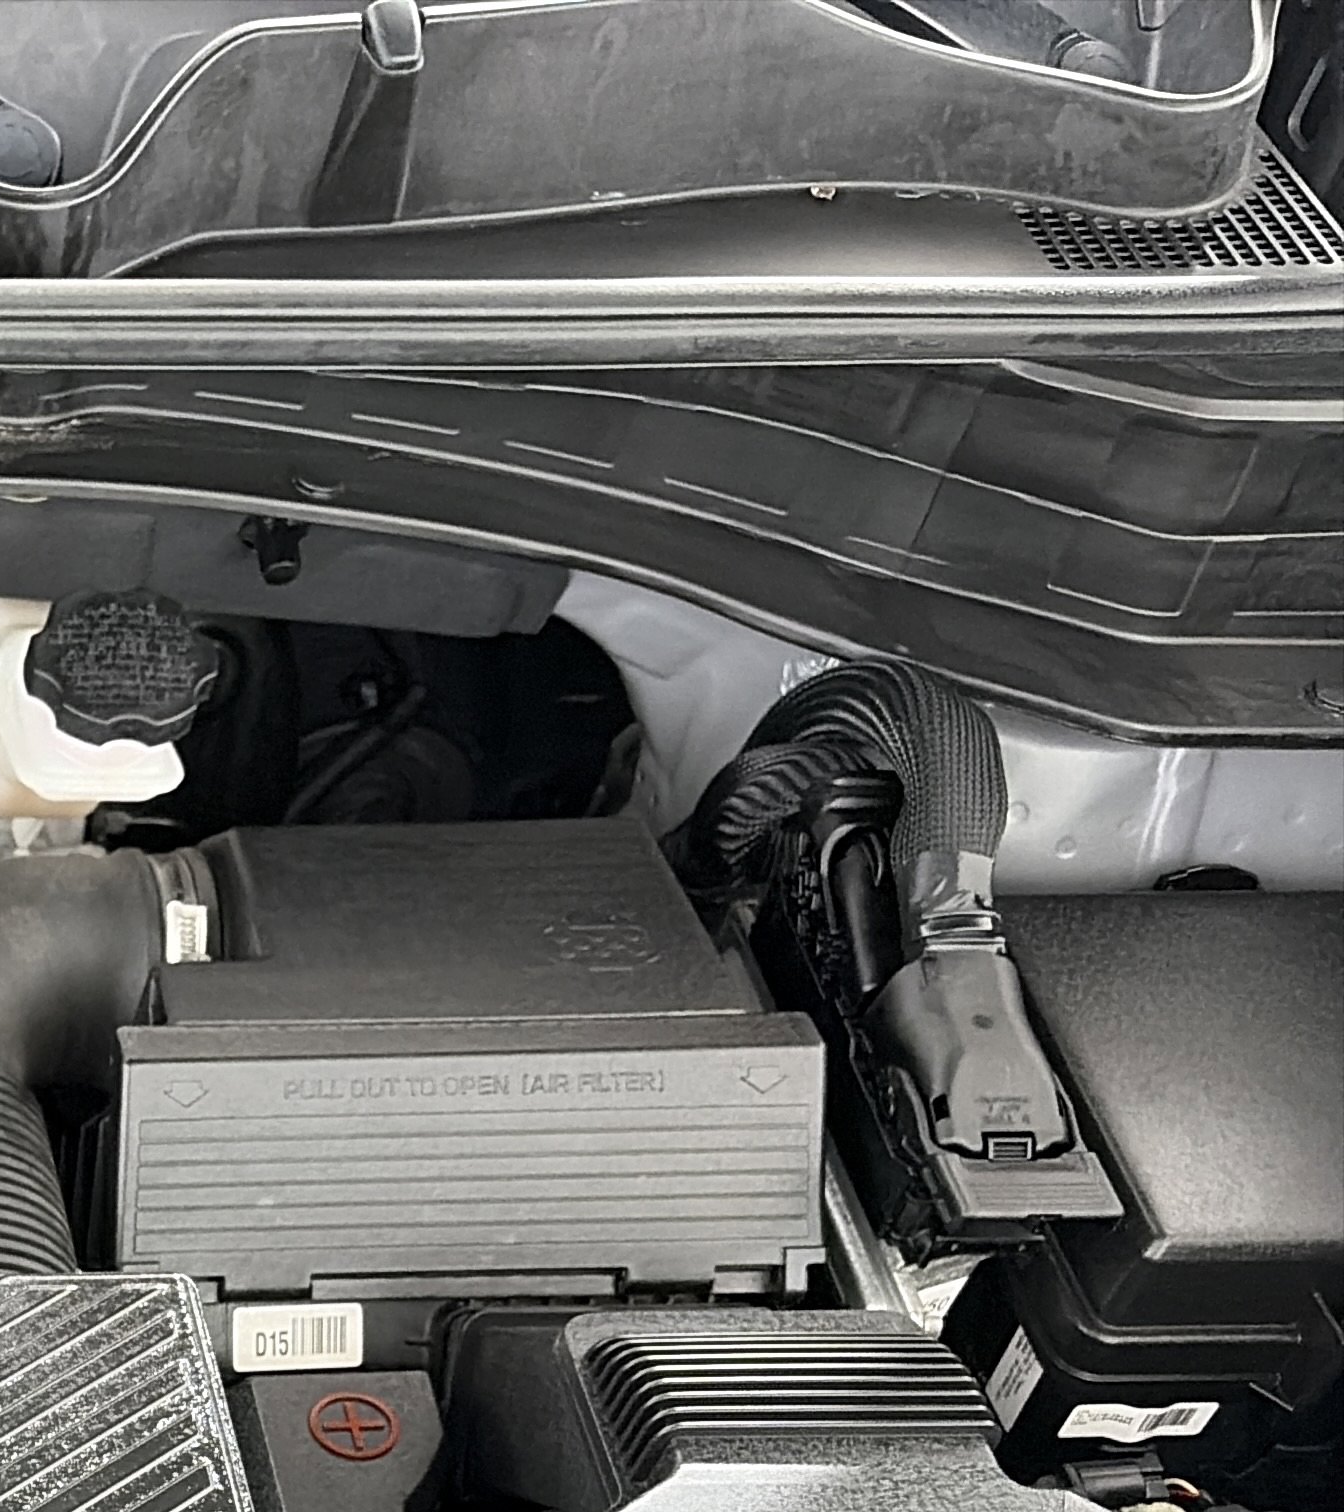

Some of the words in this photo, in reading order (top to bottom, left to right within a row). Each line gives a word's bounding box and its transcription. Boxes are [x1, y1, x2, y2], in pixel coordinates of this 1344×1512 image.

[283, 1079, 344, 1100] PULL
[350, 1077, 401, 1099] OUT
[405, 1077, 437, 1097] TO
[443, 1074, 510, 1097] OPEN
[255, 1331, 289, 1357] D15
